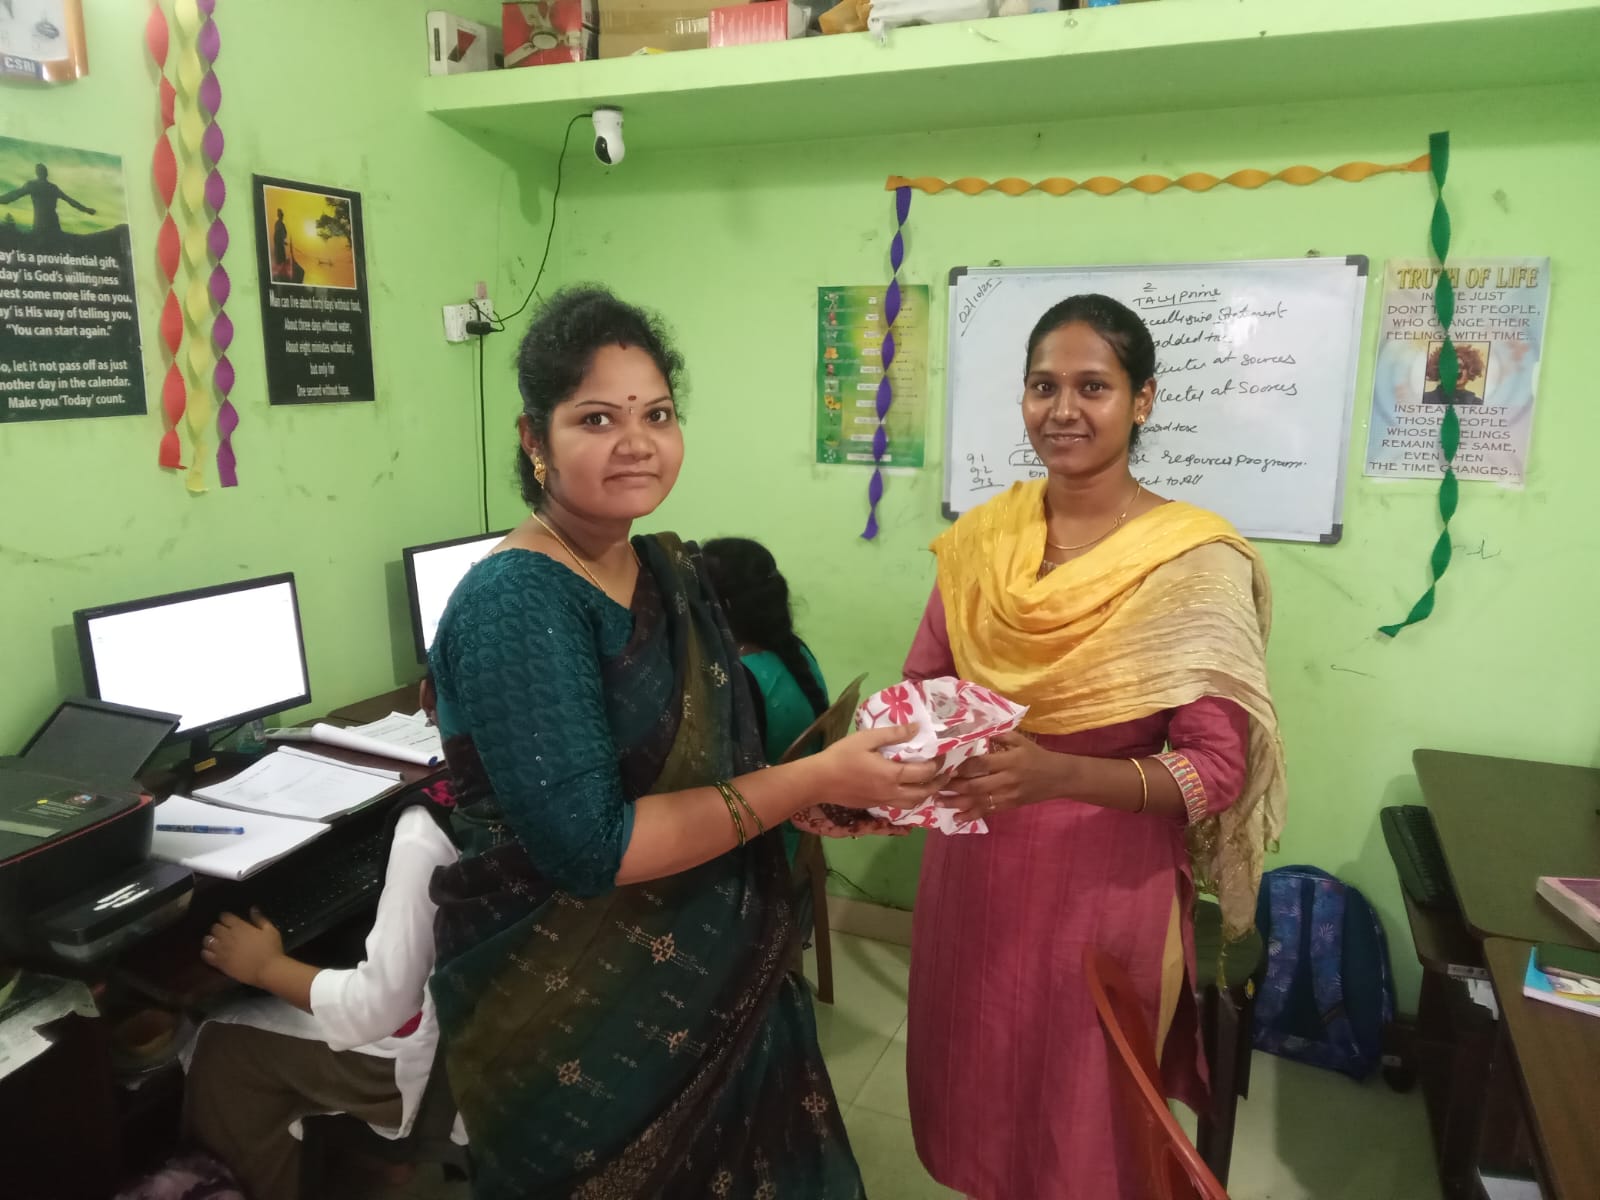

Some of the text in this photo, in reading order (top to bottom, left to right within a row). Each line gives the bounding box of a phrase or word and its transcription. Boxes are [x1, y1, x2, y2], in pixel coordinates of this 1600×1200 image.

[17, 250, 26, 262] is
[29, 254, 35, 262] a
[37, 253, 97, 267] providential
[100, 256, 118, 269] gift.
[24, 269, 32, 281] is
[34, 270, 63, 282] God's
[65, 273, 118, 287] willingness
[1466, 267, 1492, 289] OF
[1496, 266, 1540, 289] LIFE
[22, 292, 50, 300] some
[53, 292, 78, 300] more
[80, 290, 96, 300] life
[100, 293, 110, 302] on
[1470, 291, 1506, 300] JUST
[14, 306, 24, 317] is
[26, 306, 42, 318] His
[44, 309, 64, 320] way
[67, 308, 78, 318] of
[78, 308, 110, 321] telling
[1388, 305, 1428, 314] DONT
[1480, 304, 1541, 316] PEOPLE,
[1392, 318, 1424, 328] WHO
[1489, 318, 1530, 328] THEIR
[34, 326, 52, 336] can
[55, 325, 78, 336] start
[1454, 331, 1488, 340] WITH
[1213, 350, 1236, 364] at
[13, 360, 28, 372] let
[29, 360, 38, 372] it
[40, 361, 57, 372] not
[59, 362, 80, 374] pass
[82, 359, 96, 370] off
[98, 362, 108, 370] as
[109, 360, 128, 372] just
[37, 378, 56, 392] day
[58, 378, 68, 388] in
[70, 377, 86, 388] the
[88, 376, 130, 388] calendar.
[1211, 379, 1234, 396] at
[8, 396, 38, 408] Make
[39, 398, 58, 410] you
[96, 394, 126, 404] count.
[1460, 406, 1508, 416] TRUST
[1459, 418, 1508, 428] EOPLE
[1386, 428, 1438, 438] WHOSE
[1382, 440, 1434, 448] REMAIN
[1471, 442, 1516, 453] SAME,
[1404, 452, 1484, 462] EVEN HEN
[1369, 462, 1398, 471] THE
[1402, 463, 1436, 472] TIME
